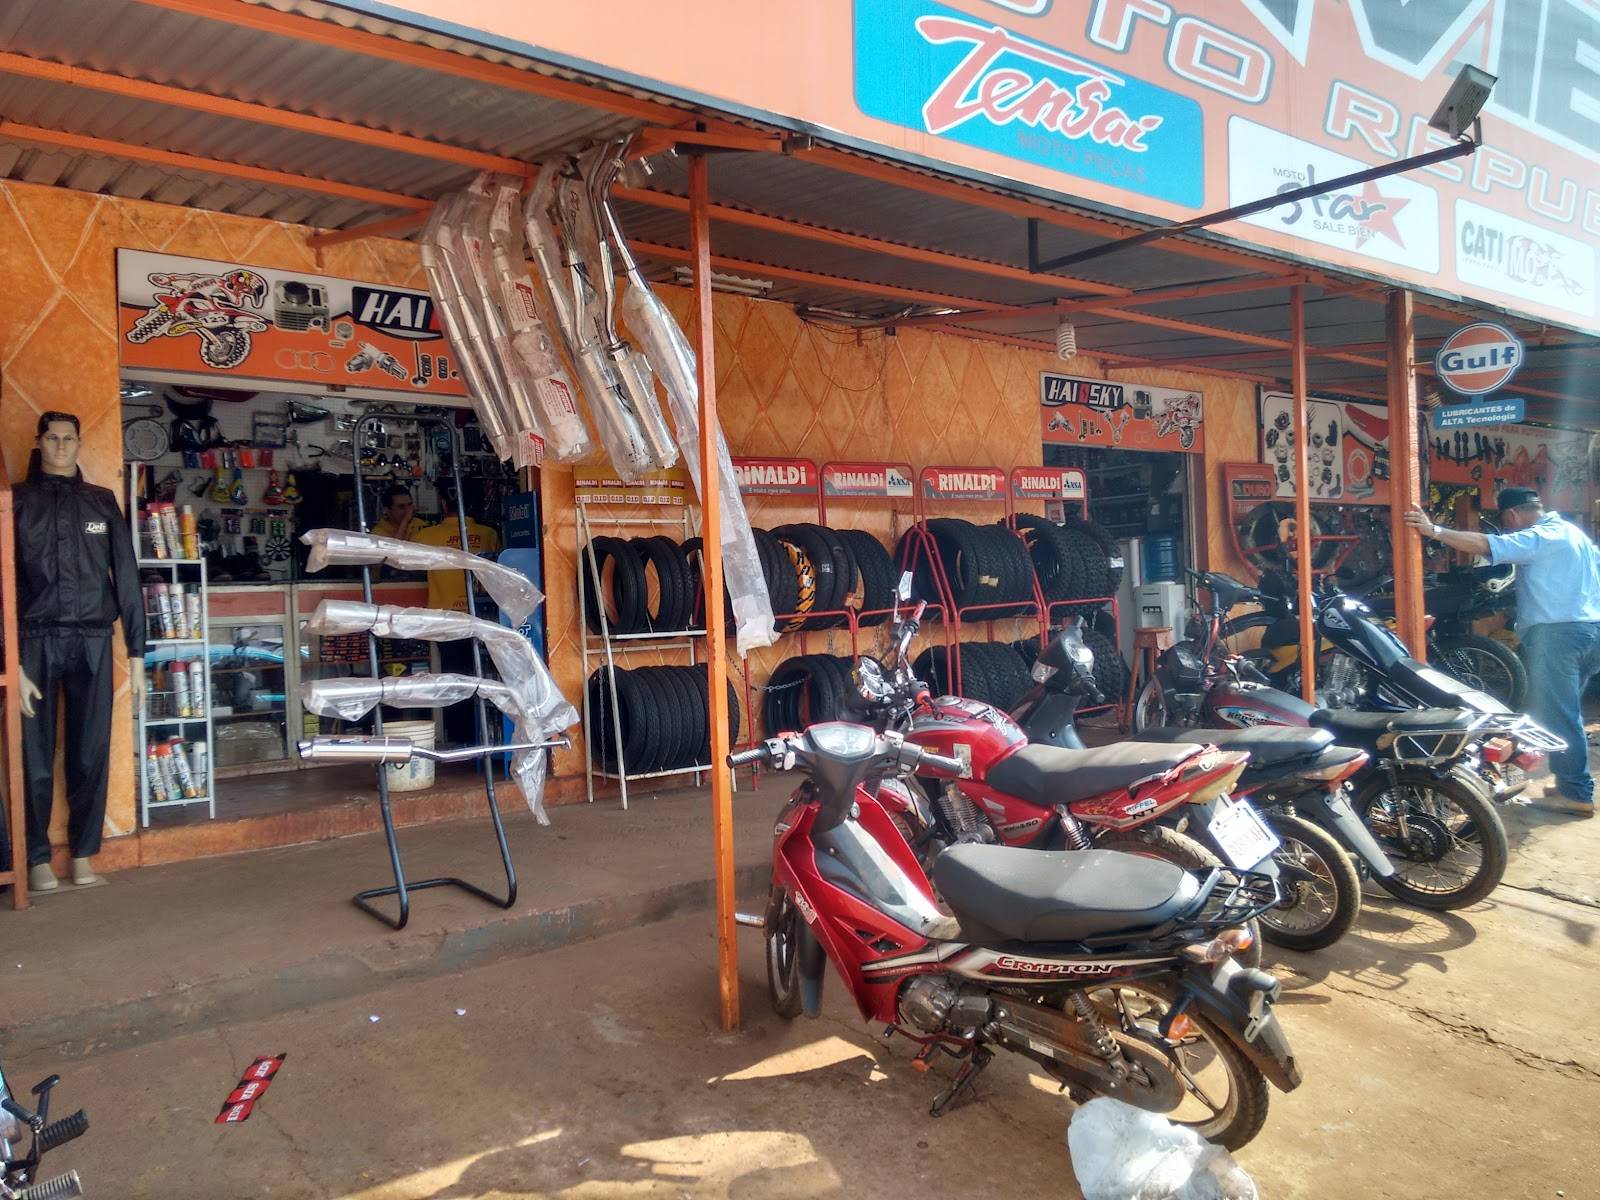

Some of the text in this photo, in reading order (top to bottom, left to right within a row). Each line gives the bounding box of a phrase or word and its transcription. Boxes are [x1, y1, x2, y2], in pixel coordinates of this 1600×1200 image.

[915, 15, 1164, 153] Tensai
[1273, 167, 1305, 181] MOTO
[1313, 219, 1376, 239] SALE BIEN
[1461, 219, 1504, 265] CATI
[1441, 346, 1516, 372] Gulf
[1441, 404, 1516, 418] LUBRICANTES de
[1441, 418, 1463, 426] ALTA
[996, 956, 1117, 975] CRYPTON
